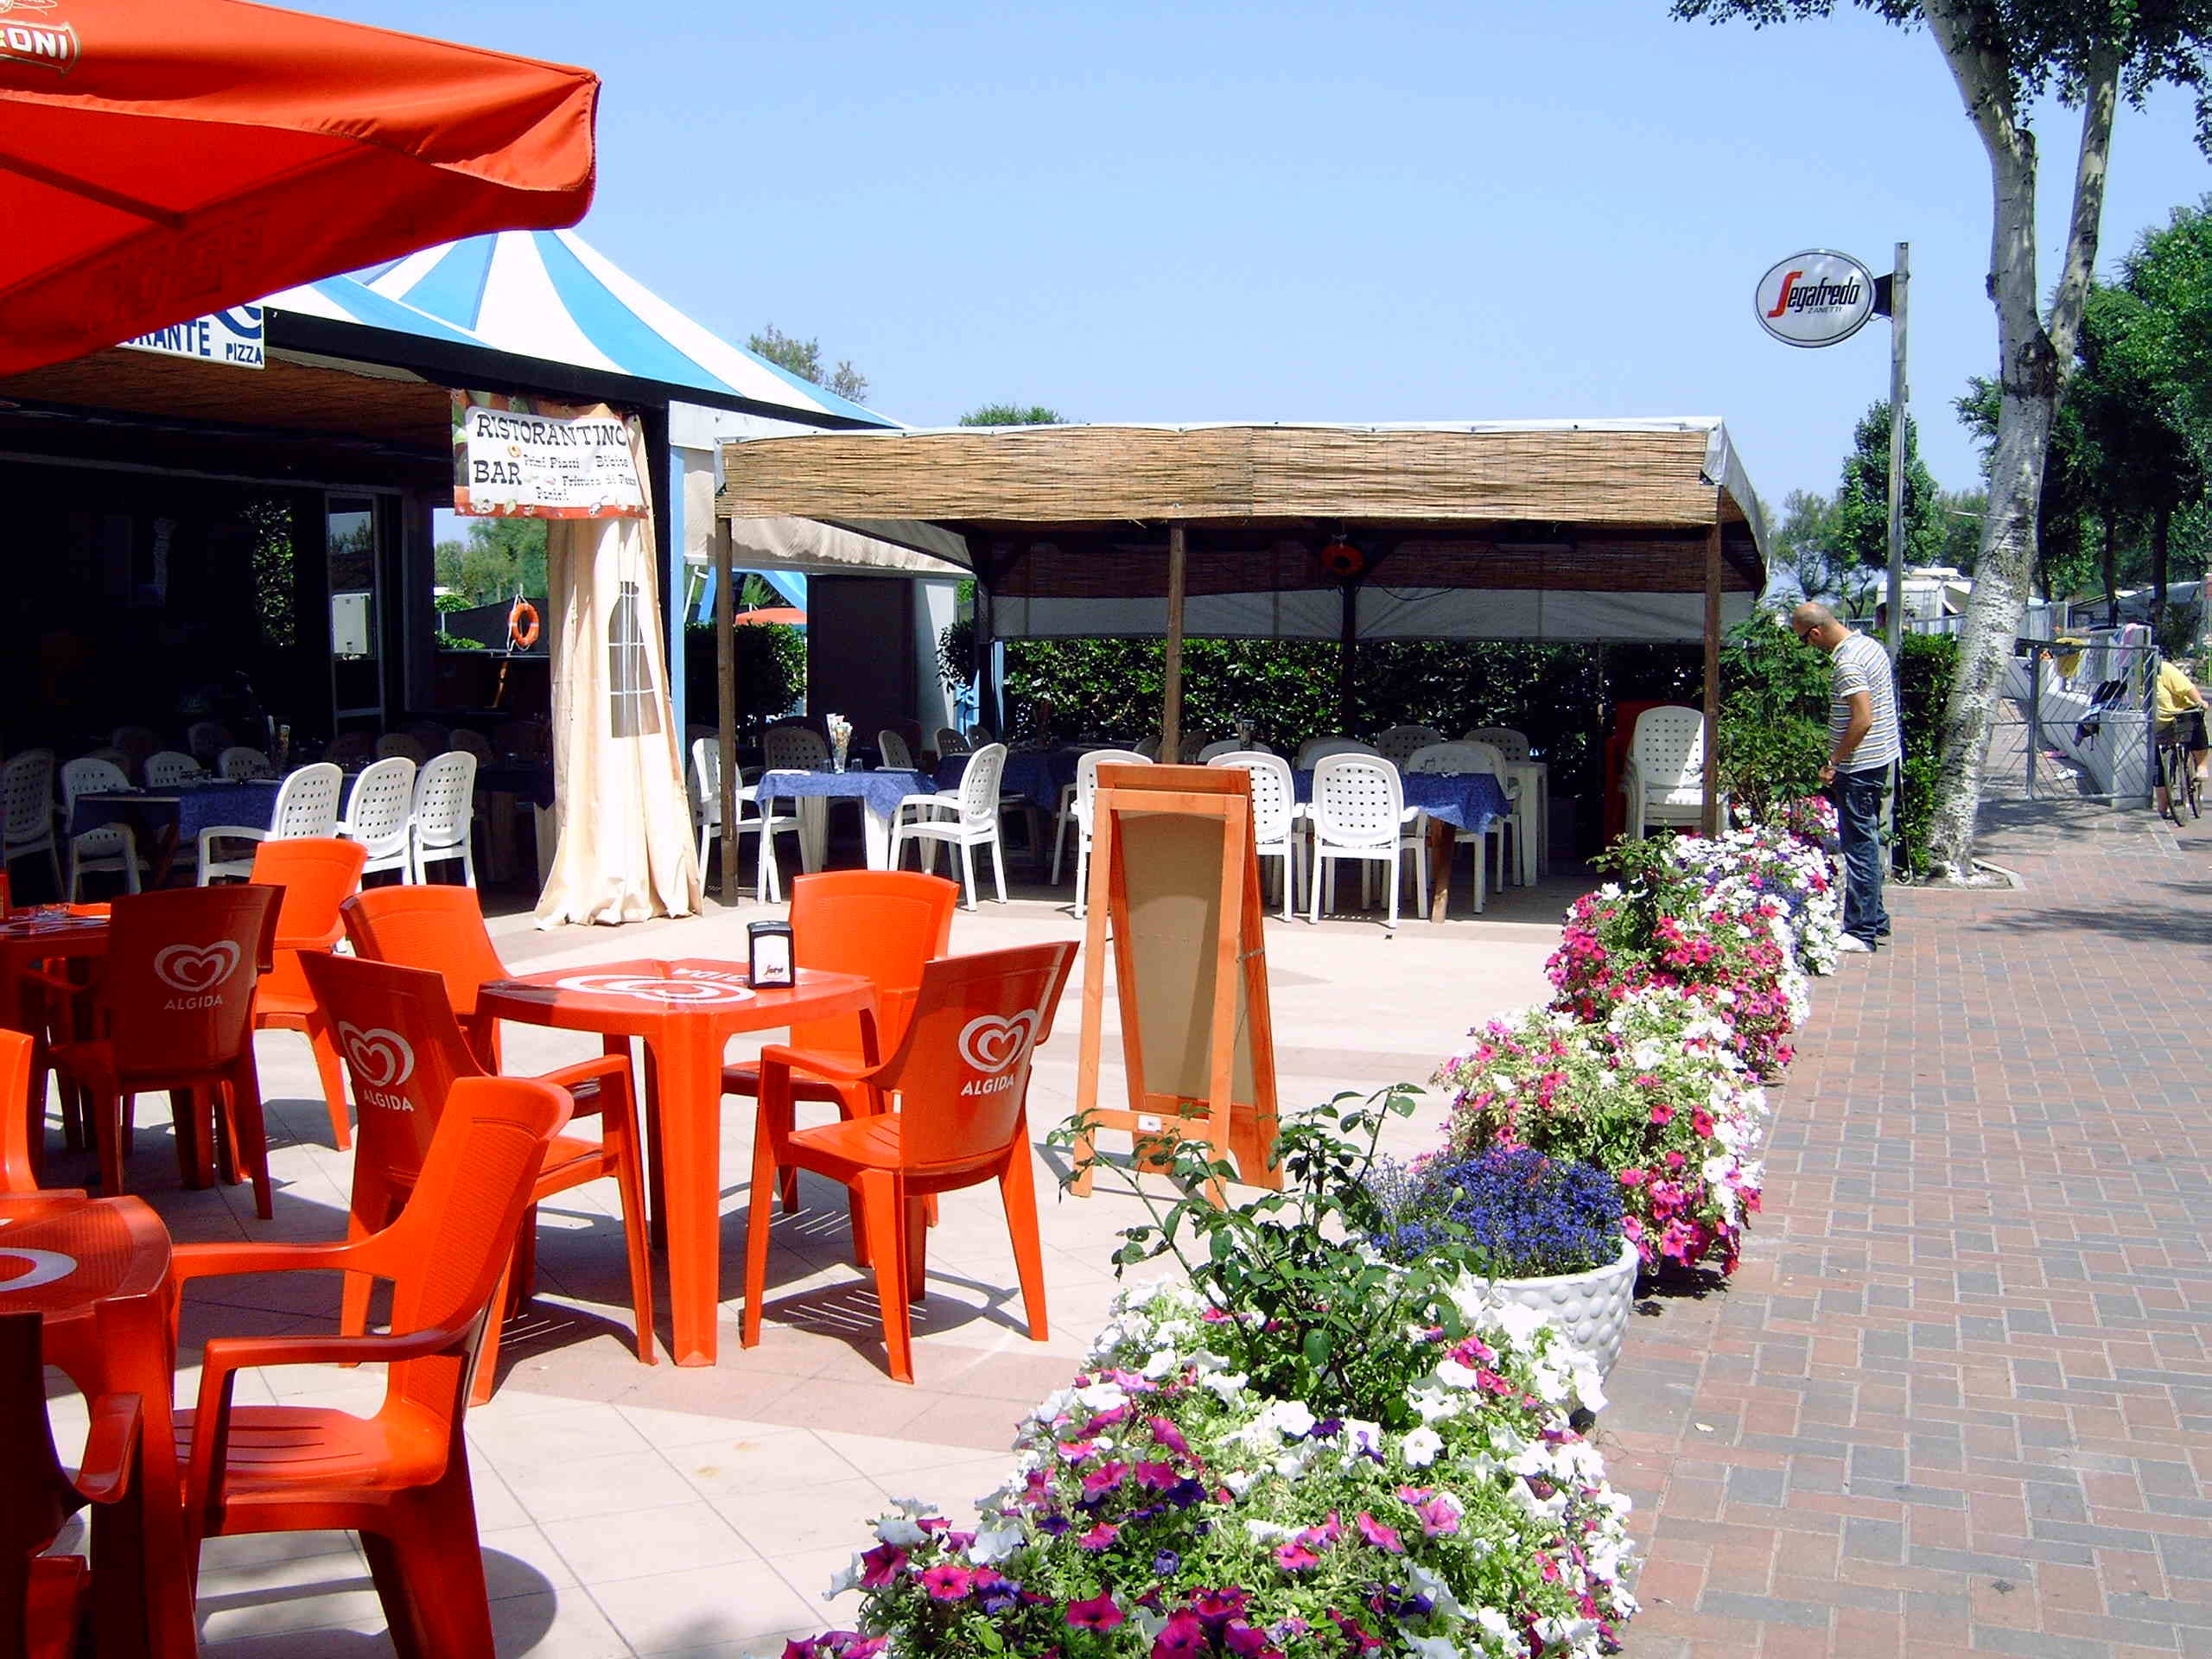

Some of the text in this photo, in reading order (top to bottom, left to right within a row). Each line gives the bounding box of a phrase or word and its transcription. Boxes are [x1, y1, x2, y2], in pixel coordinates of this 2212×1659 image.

[1766, 270, 1860, 319] Segafredo
[1808, 306, 1842, 315] ZANETTI
[226, 343, 263, 365] PIZZA
[477, 414, 627, 447] RISTORANTINO
[474, 460, 522, 486] BAR
[163, 994, 223, 1010] ALGIDA
[960, 1074, 1015, 1096] ALGIDA
[364, 1090, 415, 1112] ALGIDA
